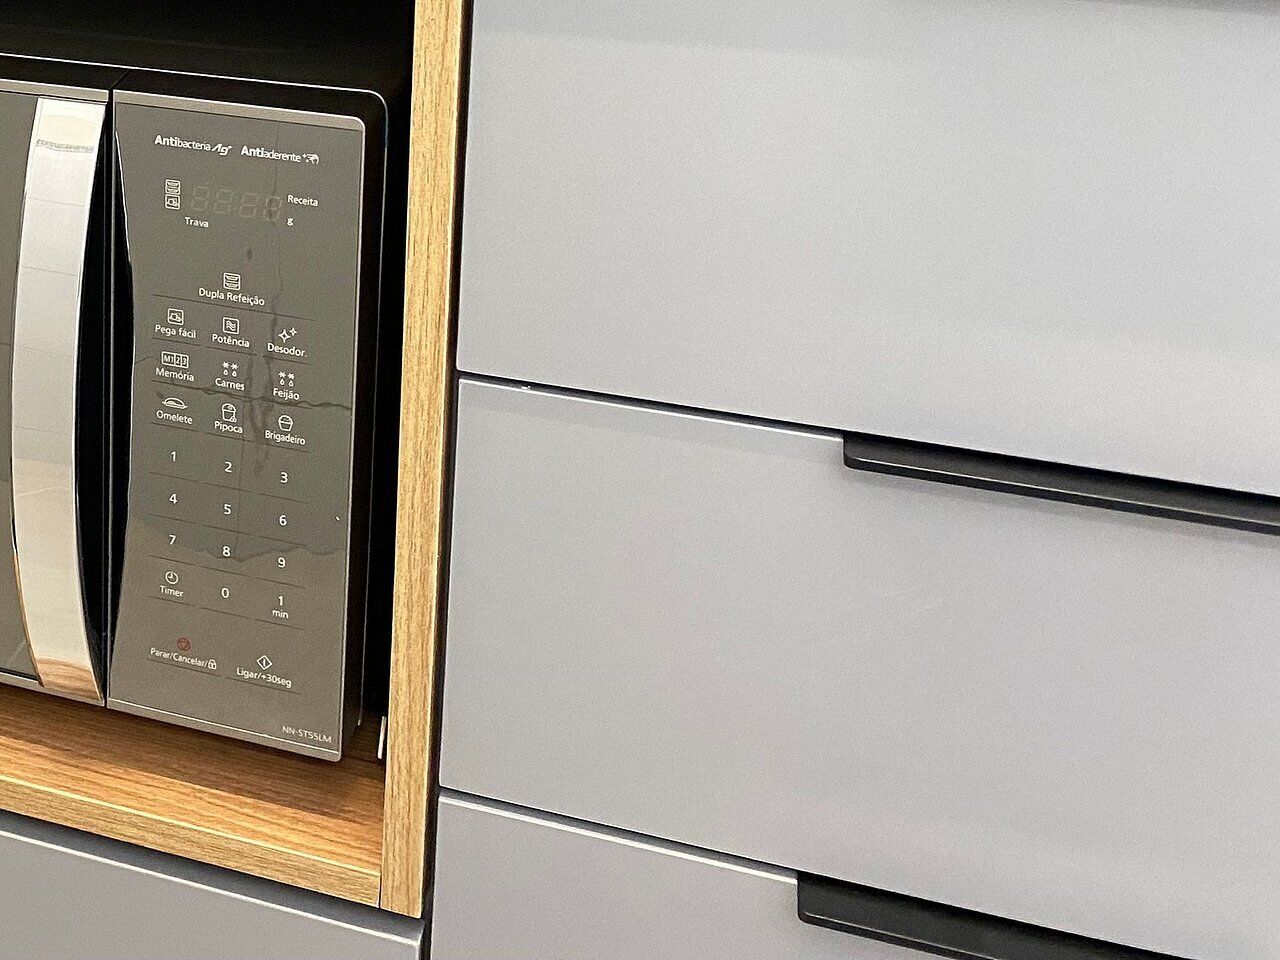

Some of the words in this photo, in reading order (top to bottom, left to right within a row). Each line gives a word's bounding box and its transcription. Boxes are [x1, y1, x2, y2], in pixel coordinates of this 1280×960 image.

[154, 134, 211, 151] Antibacteria
[240, 145, 301, 163] Antiaderente
[287, 194, 319, 208] Receita
[184, 216, 209, 228] Trava
[286, 217, 294, 226] g
[198, 287, 225, 300] Dupla
[226, 292, 265, 306] Refeição
[155, 324, 177, 336] Pega
[178, 327, 196, 339] fácil
[211, 333, 250, 348] Potência
[267, 343, 308, 357] Desodor.
[155, 367, 195, 382] Memória
[215, 378, 245, 391] Carnes
[272, 387, 300, 401] Feijão
[156, 410, 193, 424] Omelete
[214, 421, 243, 434] Pipoca
[265, 430, 306, 446] Brigadeiro
[170, 451, 177, 462] 1
[224, 461, 233, 473] 2
[280, 472, 288, 483] 3
[169, 493, 178, 504] 4
[223, 504, 232, 515] 5
[279, 514, 287, 526] 6
[169, 535, 177, 546] 7
[222, 546, 231, 557] 8
[277, 556, 286, 568] 9
[160, 585, 184, 598] Timer
[221, 588, 230, 599] 0
[277, 596, 284, 607] 1
[272, 609, 289, 620] min
[236, 667, 292, 688] Ligar/+30seg
